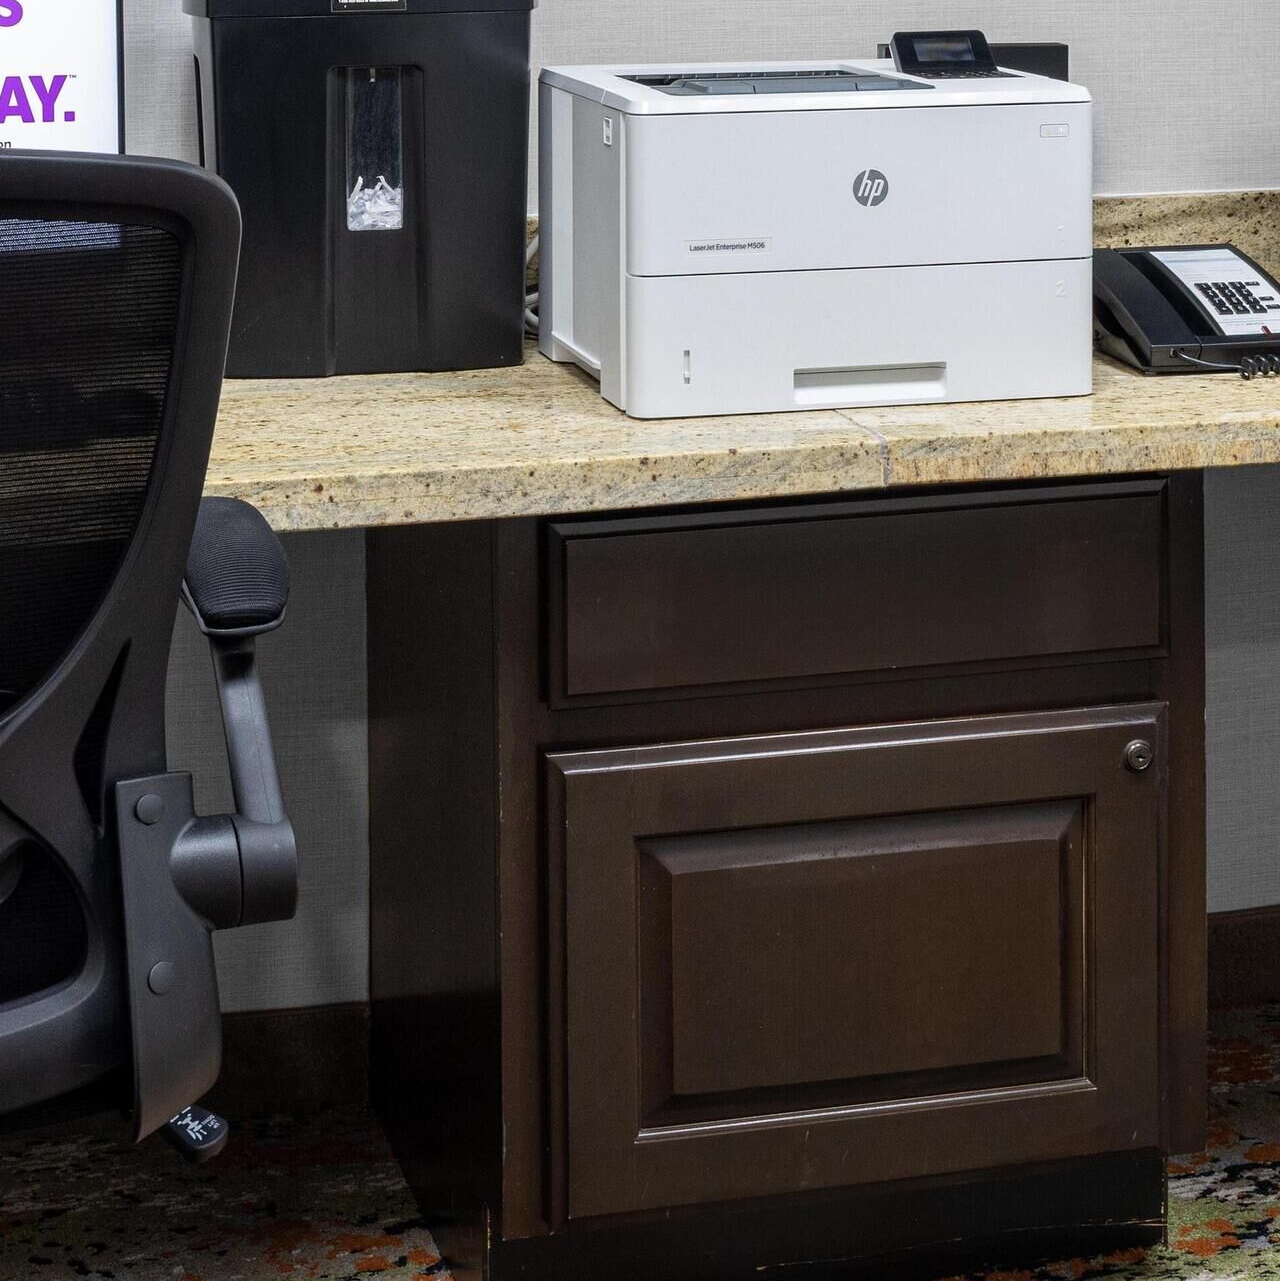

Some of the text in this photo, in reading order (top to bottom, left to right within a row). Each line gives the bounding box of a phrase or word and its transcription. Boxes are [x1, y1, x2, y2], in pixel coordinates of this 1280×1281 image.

[855, 168, 886, 206] hp
[689, 244, 715, 252] LaserJet
[716, 243, 747, 251] Enterprise
